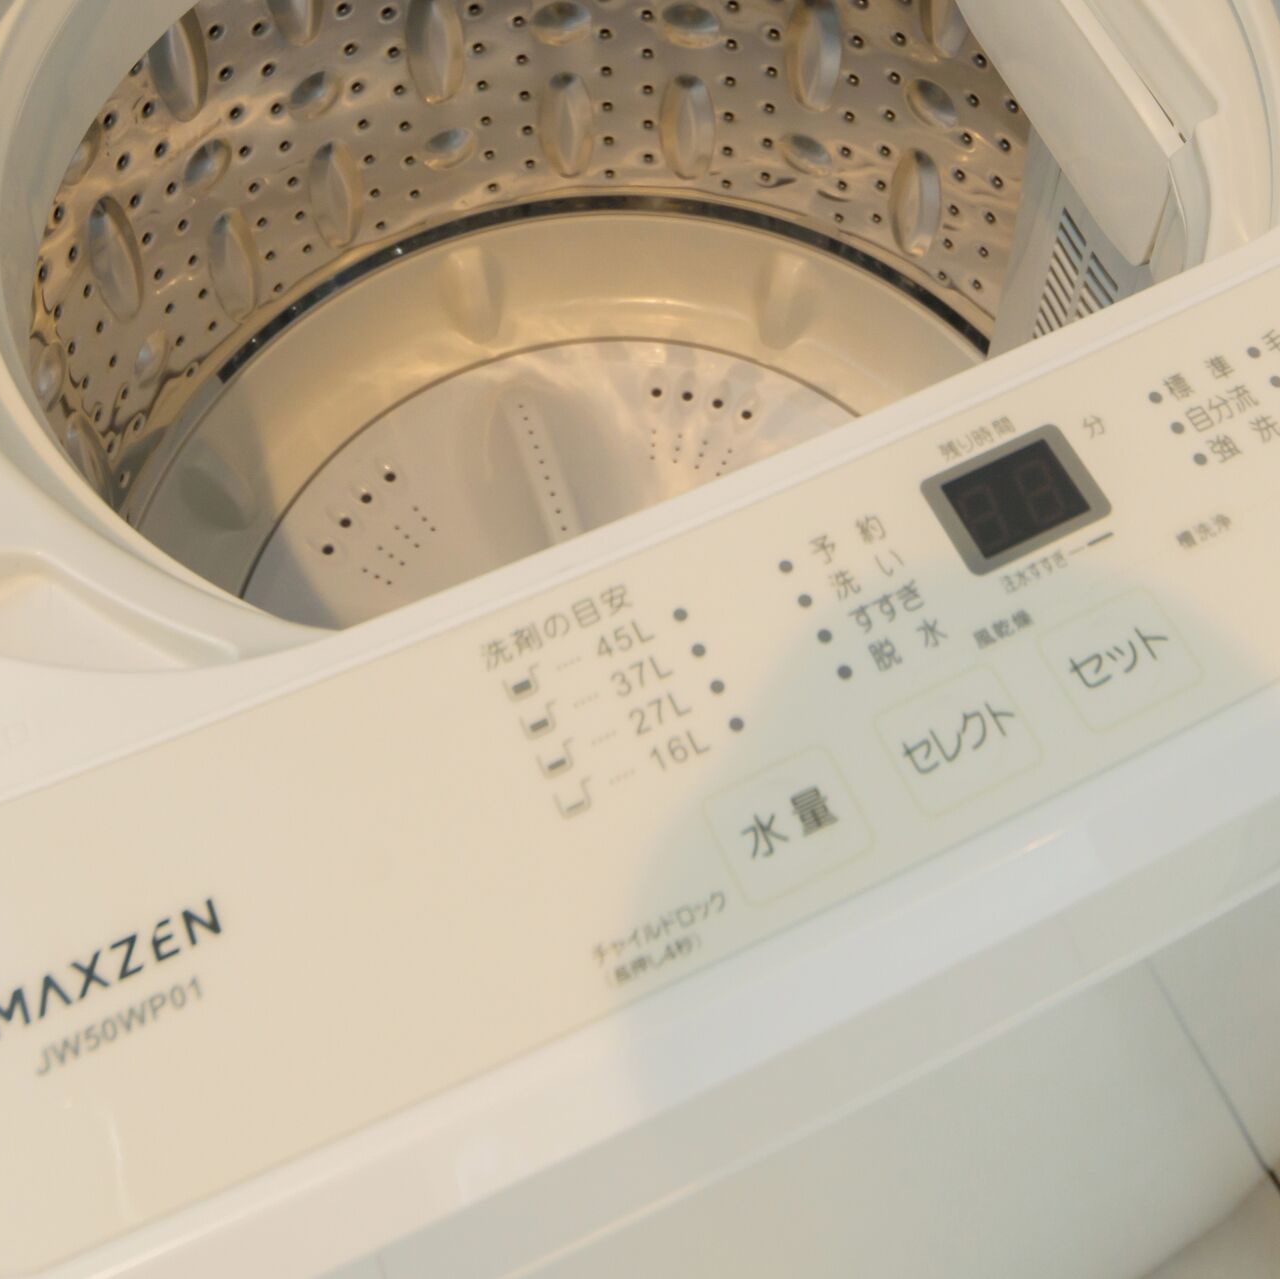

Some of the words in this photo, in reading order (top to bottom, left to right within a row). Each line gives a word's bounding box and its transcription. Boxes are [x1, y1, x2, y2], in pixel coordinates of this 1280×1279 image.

[1081, 413, 1108, 441] 分
[1185, 384, 1260, 433] 自分流
[936, 415, 1017, 463] 残り時間
[479, 583, 633, 671] 洗剤の目安
[848, 579, 925, 633] すすぎ
[595, 622, 657, 661] 45L
[1068, 625, 1169, 690] セット
[610, 657, 675, 699] 37L
[628, 693, 693, 737] 27L
[902, 700, 1015, 776] セレクト
[648, 728, 713, 773] 16L
[740, 784, 839, 861] 水量
[591, 890, 728, 969] チャイルドロック
[34, 975, 205, 1077] JW50WP01
